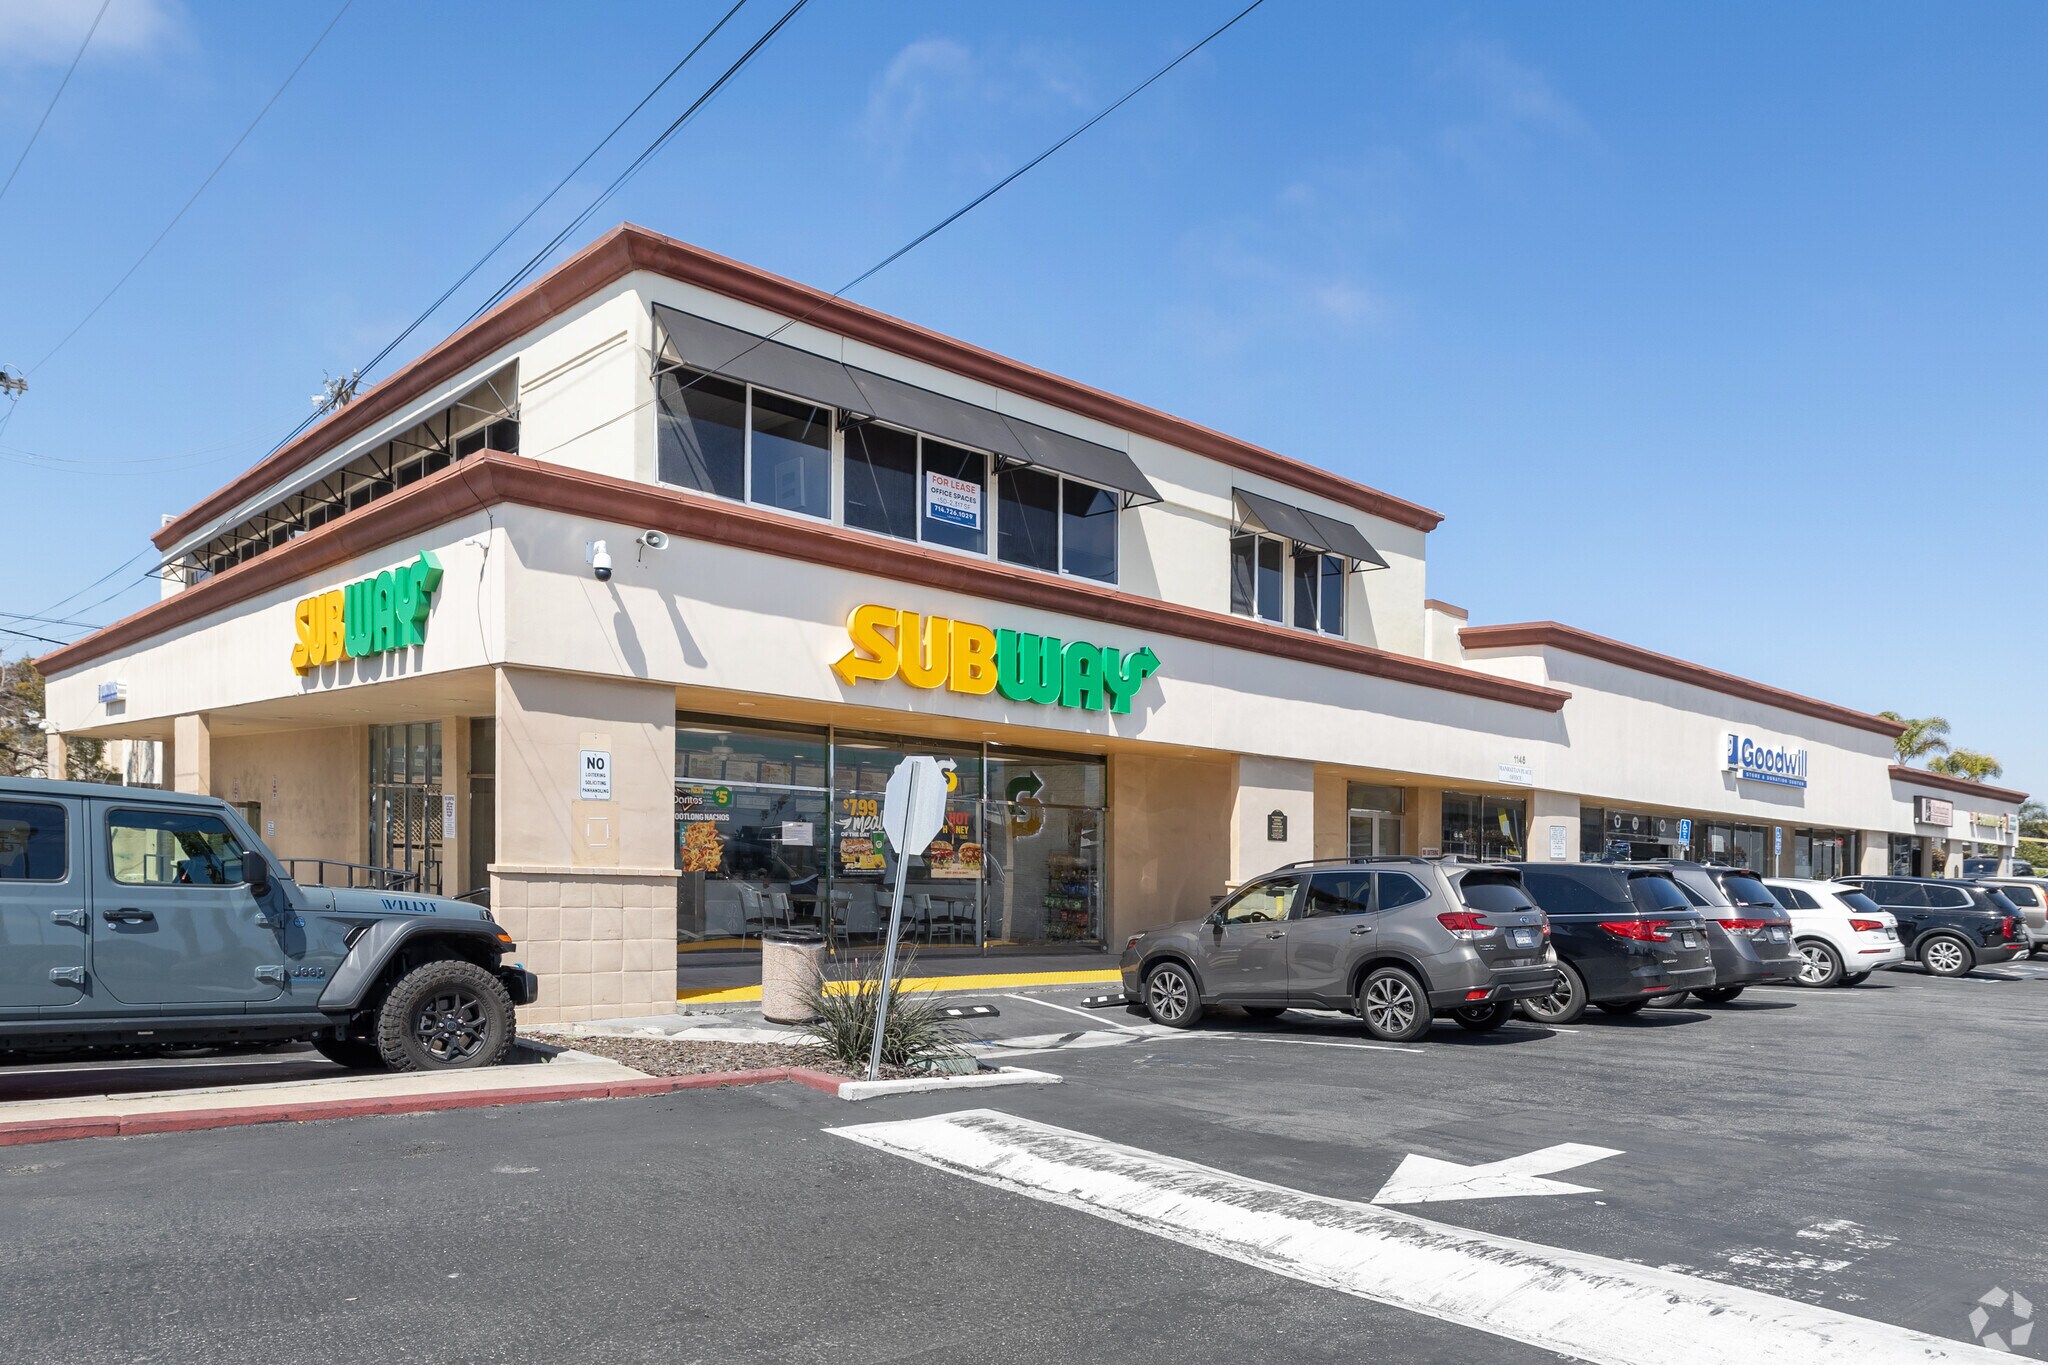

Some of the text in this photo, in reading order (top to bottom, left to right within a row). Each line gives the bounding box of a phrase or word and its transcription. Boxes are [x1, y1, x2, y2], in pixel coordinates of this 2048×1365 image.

[932, 475, 976, 494] FOR LEASE
[930, 486, 977, 504] OFFICE SPACES
[290, 549, 444, 677] SUBWAY
[829, 603, 1161, 715] SUBWAY
[586, 756, 605, 770] NO
[1741, 737, 1808, 778] Goodwill
[1766, 774, 1788, 784] DONATION
[1788, 779, 1805, 787] CENTER
[674, 795, 704, 805] Doritos
[715, 790, 729, 804] $5
[843, 798, 878, 817] $7.99
[674, 812, 730, 821] OOTLONG NACHOS
[948, 811, 970, 825] HOT
[381, 899, 436, 912] WILLYS
[290, 964, 325, 978] Jeep
